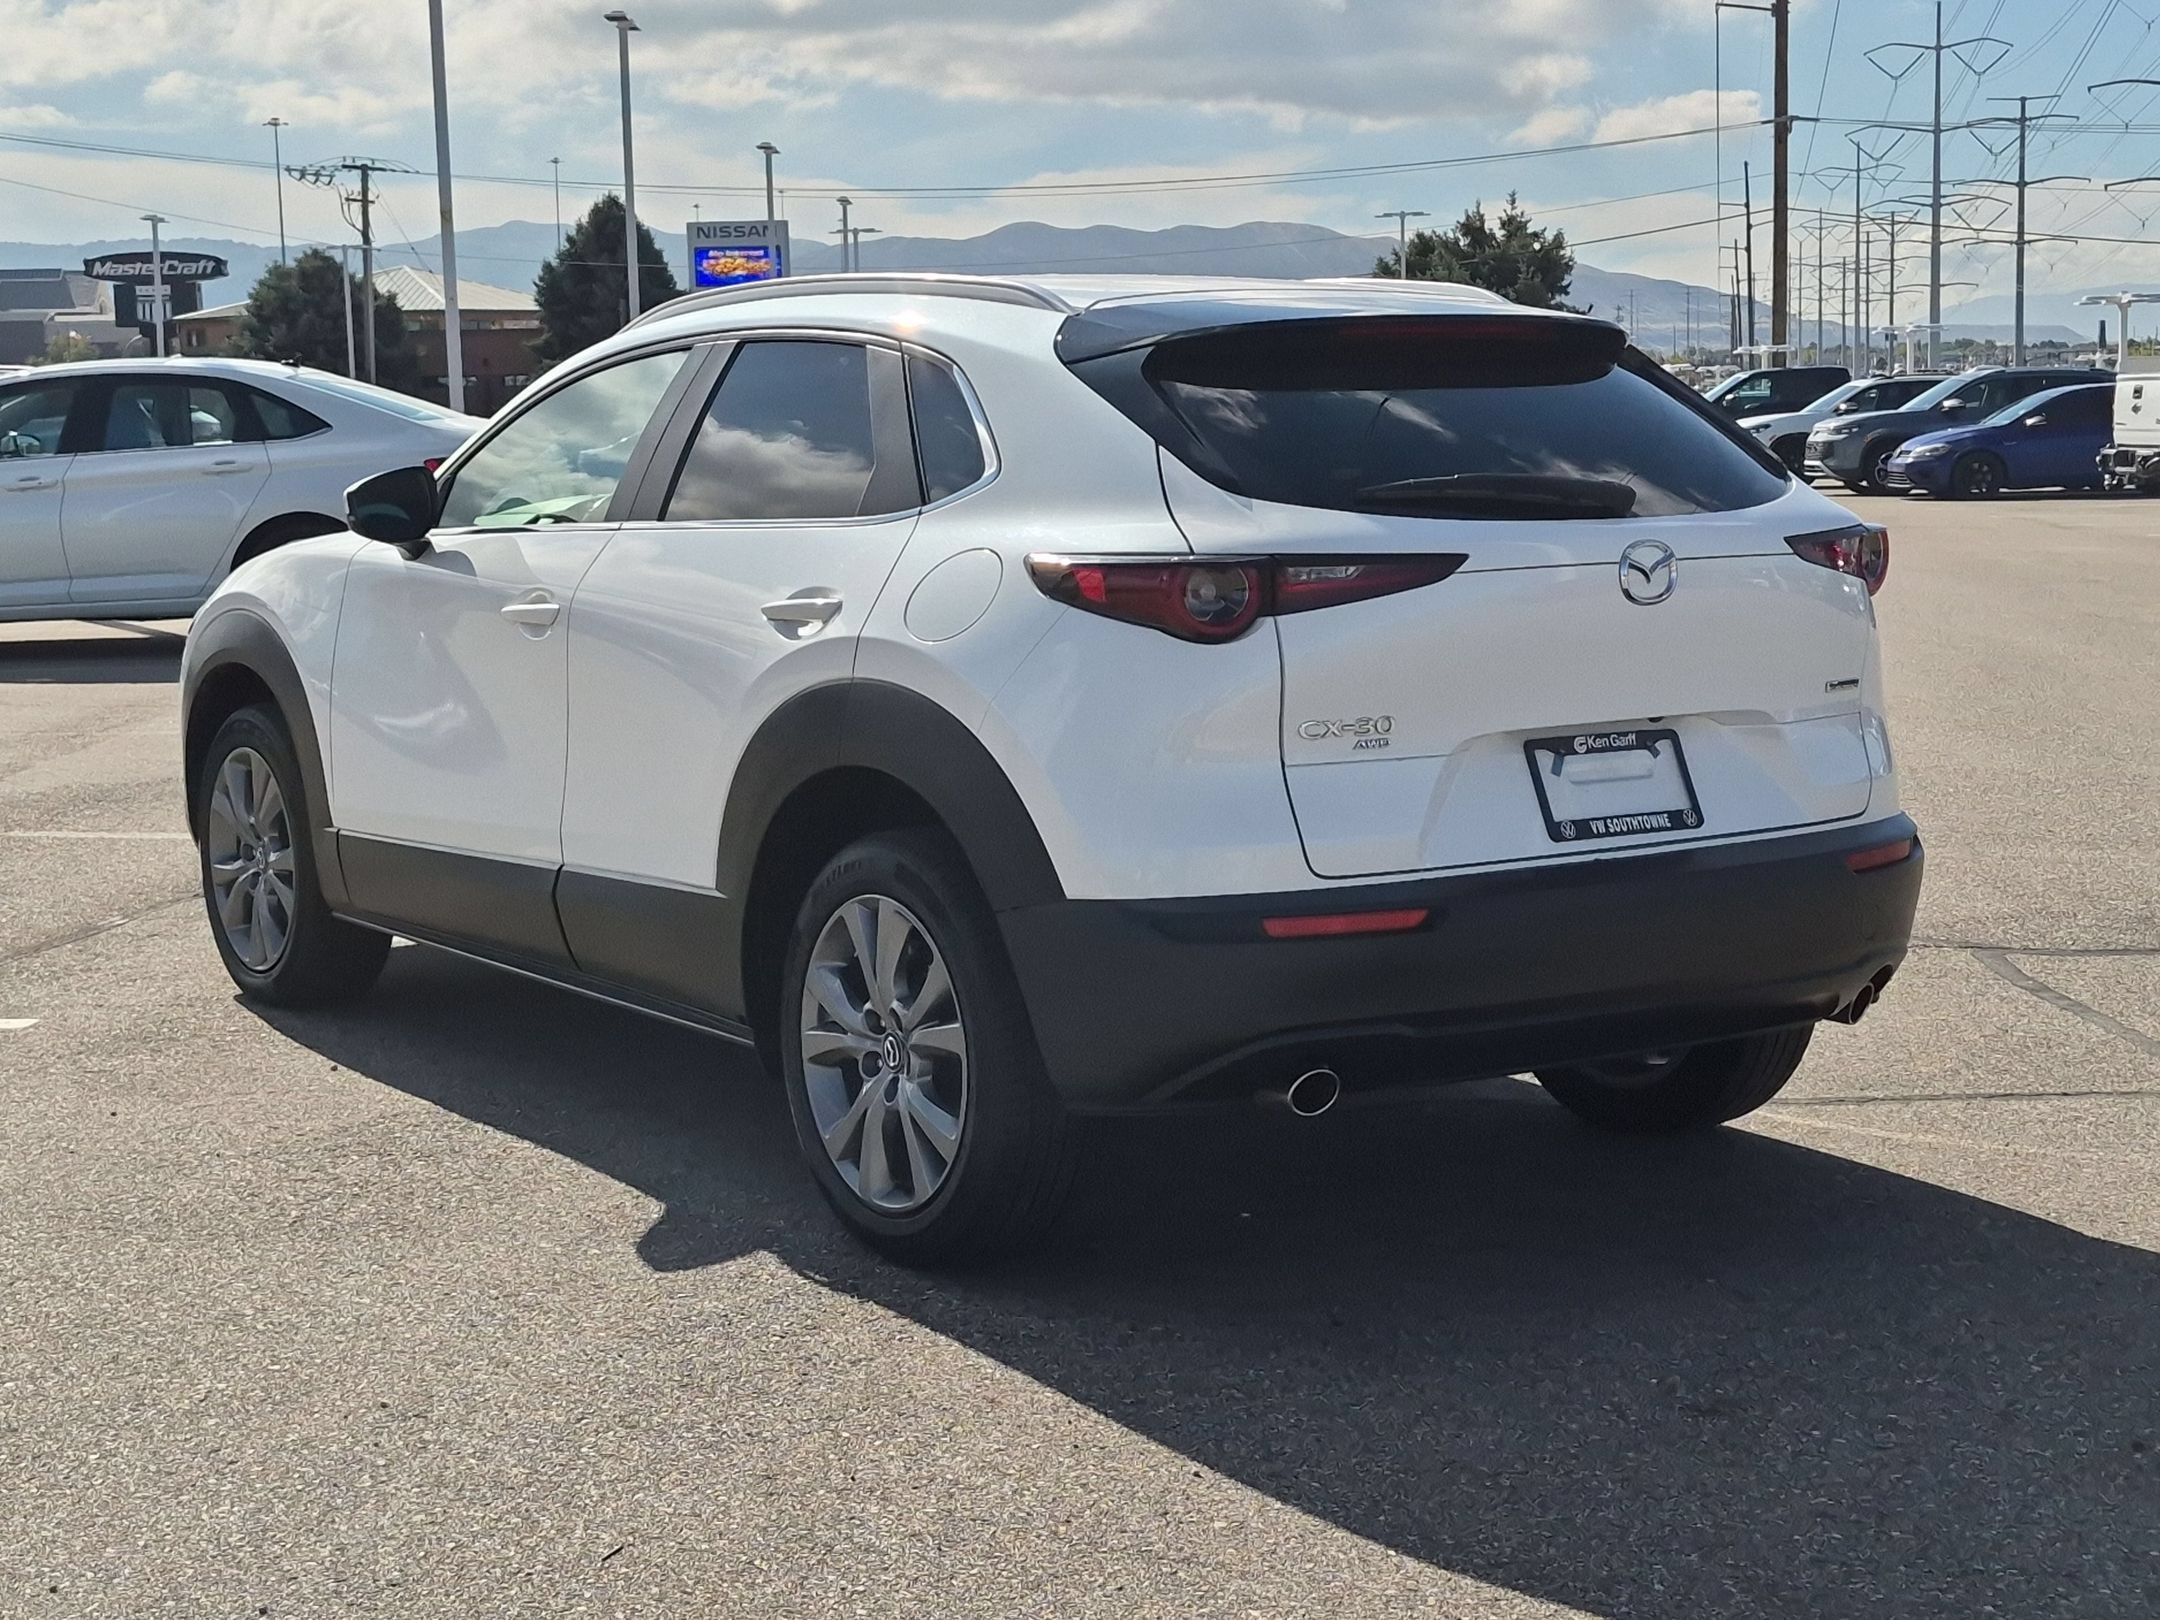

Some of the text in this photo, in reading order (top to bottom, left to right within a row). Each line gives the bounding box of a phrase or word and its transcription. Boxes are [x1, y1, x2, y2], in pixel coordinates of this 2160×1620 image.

[1298, 715, 1395, 740] CX-30
[1352, 738, 1390, 750] AWD
[1587, 732, 1636, 748] Ken Garff
[1589, 813, 1672, 834] VW SOUTHTOWNE
